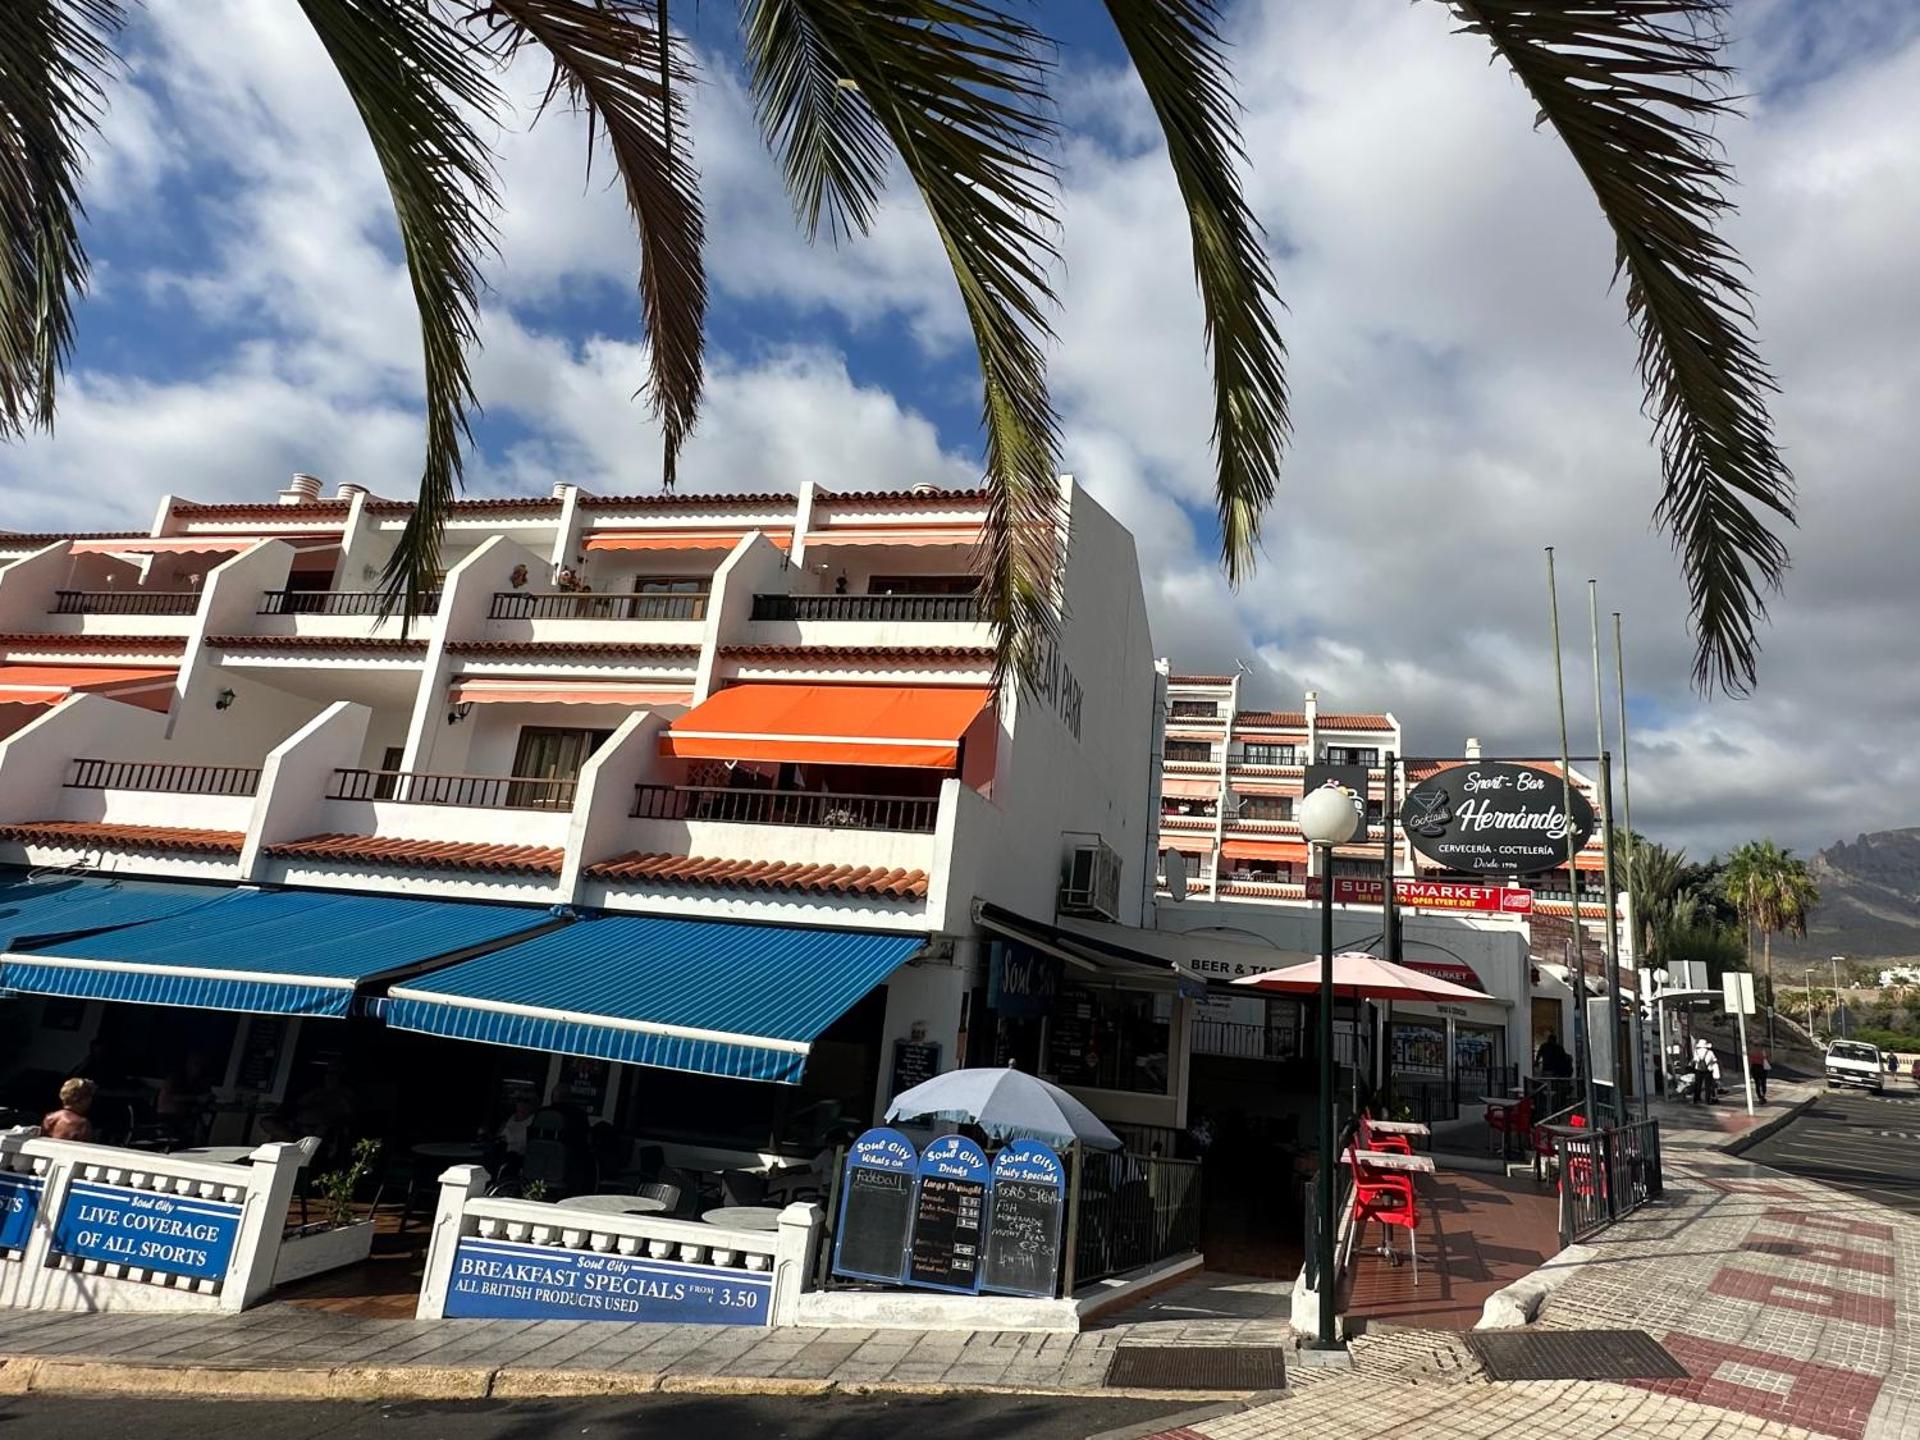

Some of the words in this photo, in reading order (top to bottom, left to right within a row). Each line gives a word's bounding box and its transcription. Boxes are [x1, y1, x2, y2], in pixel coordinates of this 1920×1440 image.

[1060, 663, 1084, 744] PARK
[1463, 772, 1509, 793] Sport
[1517, 772, 1545, 791] Bar
[1438, 843, 1491, 854] CERVECERÍA
[1498, 844, 1554, 855] COCTELERÍA
[1341, 880, 1495, 900] SUPRMARKET
[1412, 897, 1434, 906] OPEN
[1435, 898, 1458, 907] EVERY
[1459, 899, 1476, 908] DAY
[1191, 960, 1229, 973] BEER
[1235, 964, 1244, 974] &
[857, 1140, 886, 1153] Soul
[888, 1142, 912, 1160] City
[927, 1149, 956, 1162] Soul
[959, 1151, 983, 1168] City
[938, 1163, 968, 1177] Drinks
[999, 1152, 1029, 1165] Soul
[1032, 1154, 1057, 1171] City
[995, 1166, 1019, 1178] Daily
[1022, 1169, 1057, 1183] Specials
[131, 1196, 153, 1210] Soul
[155, 1199, 175, 1214] City
[77, 1205, 118, 1226] LIVE
[122, 1213, 220, 1243] COVERAGE
[76, 1231, 102, 1249] OF
[103, 1238, 136, 1255] ALL
[139, 1241, 207, 1267] SPORTS
[576, 1255, 605, 1271] Soul
[607, 1258, 630, 1275] City
[459, 1258, 580, 1288] BREAKFAST
[583, 1273, 685, 1301] SPECIALS
[689, 1285, 714, 1294] FROM
[719, 1288, 758, 1310] 3.50
[454, 1279, 479, 1294] ALL
[481, 1281, 533, 1301] BRITISH
[534, 1287, 602, 1311] PRODUCTS
[603, 1297, 639, 1314] USED
